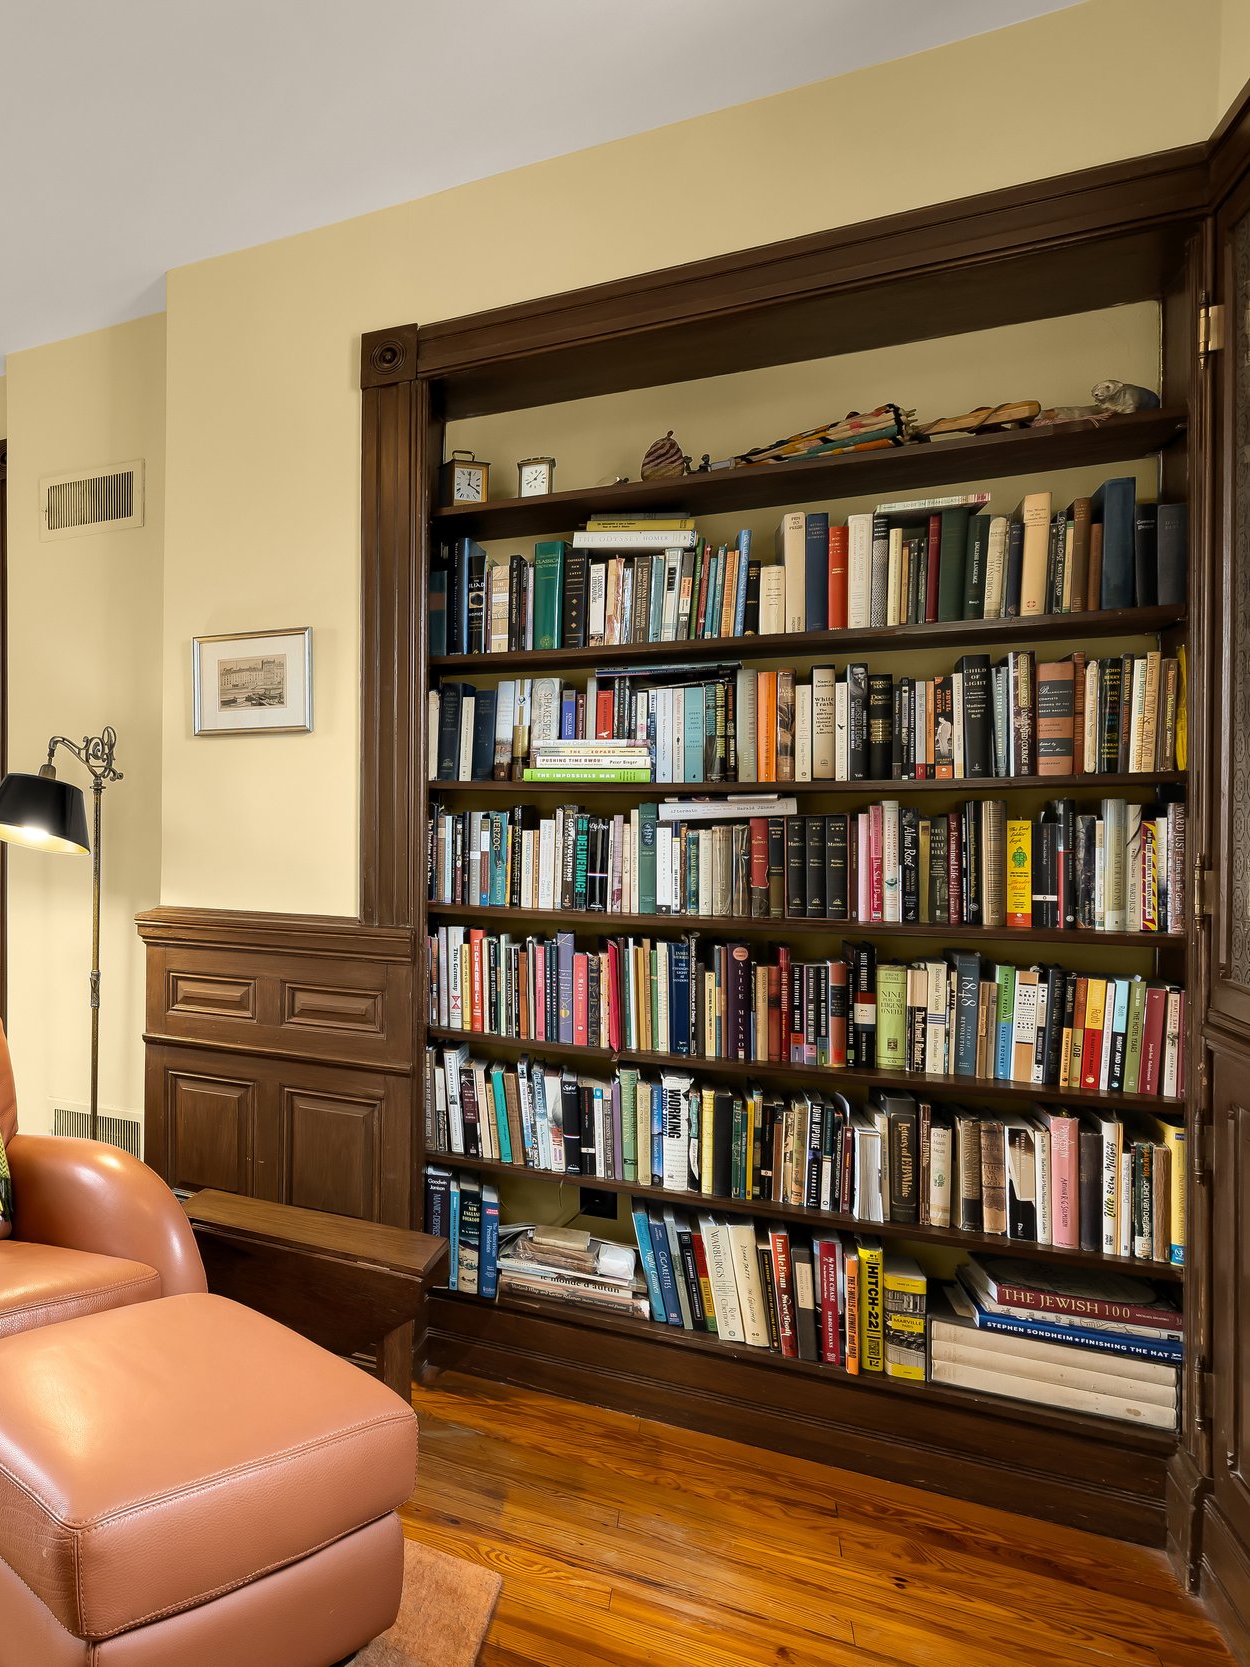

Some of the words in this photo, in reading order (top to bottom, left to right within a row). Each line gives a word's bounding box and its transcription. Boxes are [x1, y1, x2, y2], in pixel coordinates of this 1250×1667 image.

[543, 693, 552, 740] SHAKESPEA
[854, 699, 862, 726] CURSED
[854, 727, 862, 751] LEGACY
[493, 815, 501, 851] HERZOG
[904, 826, 916, 847] Alma
[950, 832, 958, 864] Examined
[575, 835, 588, 893] DELIVERANCE
[950, 866, 958, 878] Life
[958, 976, 977, 1007] 1848
[915, 1011, 925, 1022] The
[915, 1023, 924, 1042] Orwell
[1130, 1038, 1138, 1053] YEARS
[914, 1043, 924, 1064] Reader
[1073, 1043, 1081, 1058] JOB
[668, 1089, 682, 1139] WORKING
[812, 1105, 822, 1122] JOHN
[811, 1124, 821, 1149] UPDIKE
[433, 1194, 441, 1236] MANIC-DEPRE
[710, 1229, 726, 1278] WARBURGS
[775, 1238, 784, 1253] Ian
[658, 1251, 672, 1289] CIGARETTES
[777, 1254, 787, 1288] McEwan
[867, 1265, 880, 1329] HITCH-22
[1002, 1289, 1035, 1304] THE
[1040, 1295, 1098, 1314] JEWISH
[1104, 1304, 1130, 1319] 100
[987, 1321, 1024, 1333] STEPHEN
[1027, 1328, 1073, 1341] SONDHEIM
[1081, 1337, 1127, 1351] FINISHING
[1129, 1346, 1149, 1355] THE
[1151, 1349, 1168, 1358] HAT
